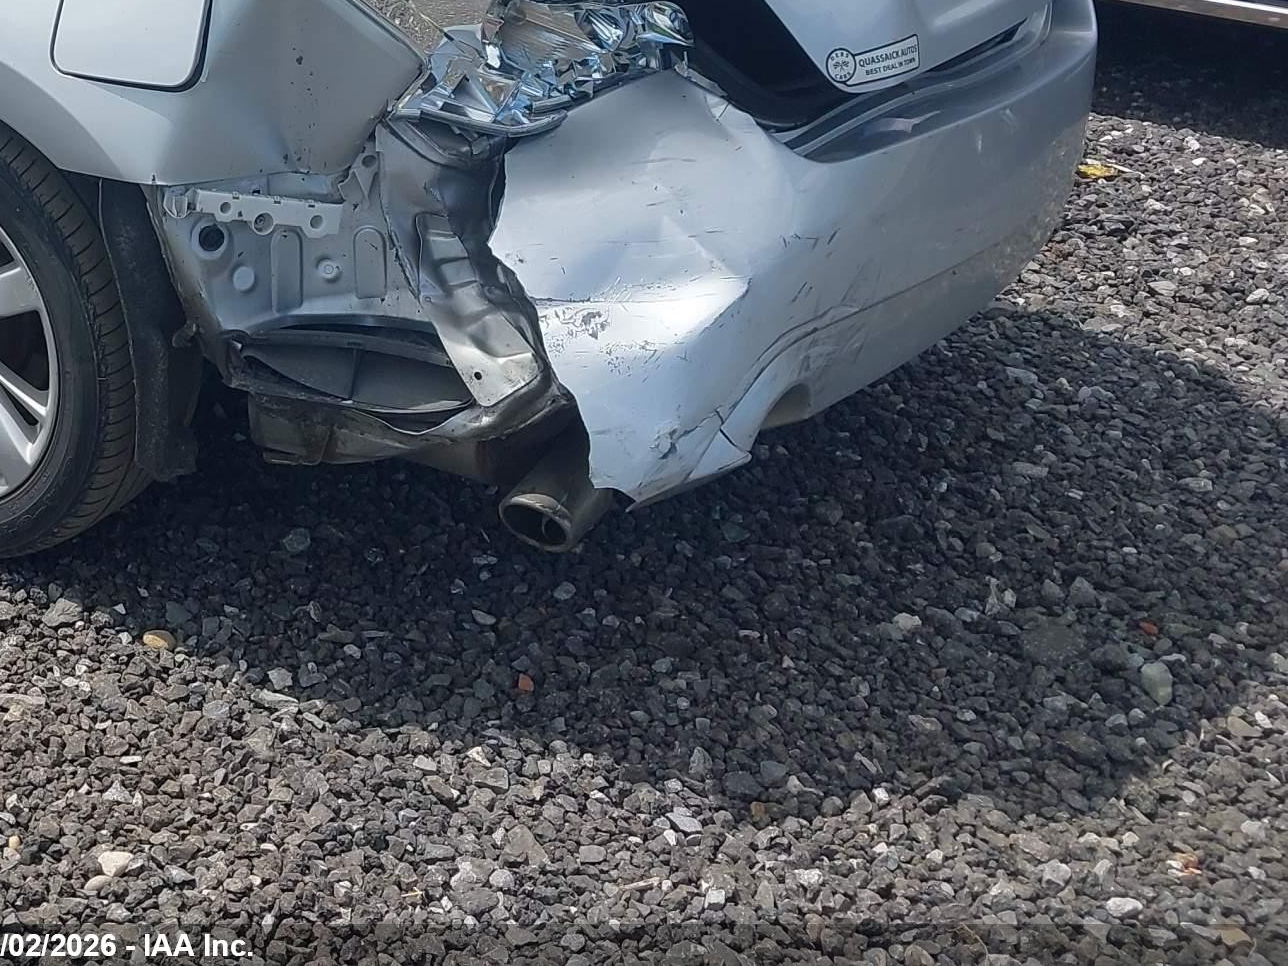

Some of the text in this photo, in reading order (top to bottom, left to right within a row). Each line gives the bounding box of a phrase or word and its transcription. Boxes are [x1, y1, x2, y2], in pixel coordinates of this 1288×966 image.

[858, 44, 917, 68] QUASSAICK AUTOS
[865, 67, 882, 76] BEST
[883, 63, 898, 73] DEAL
[904, 57, 916, 67] TOWN
